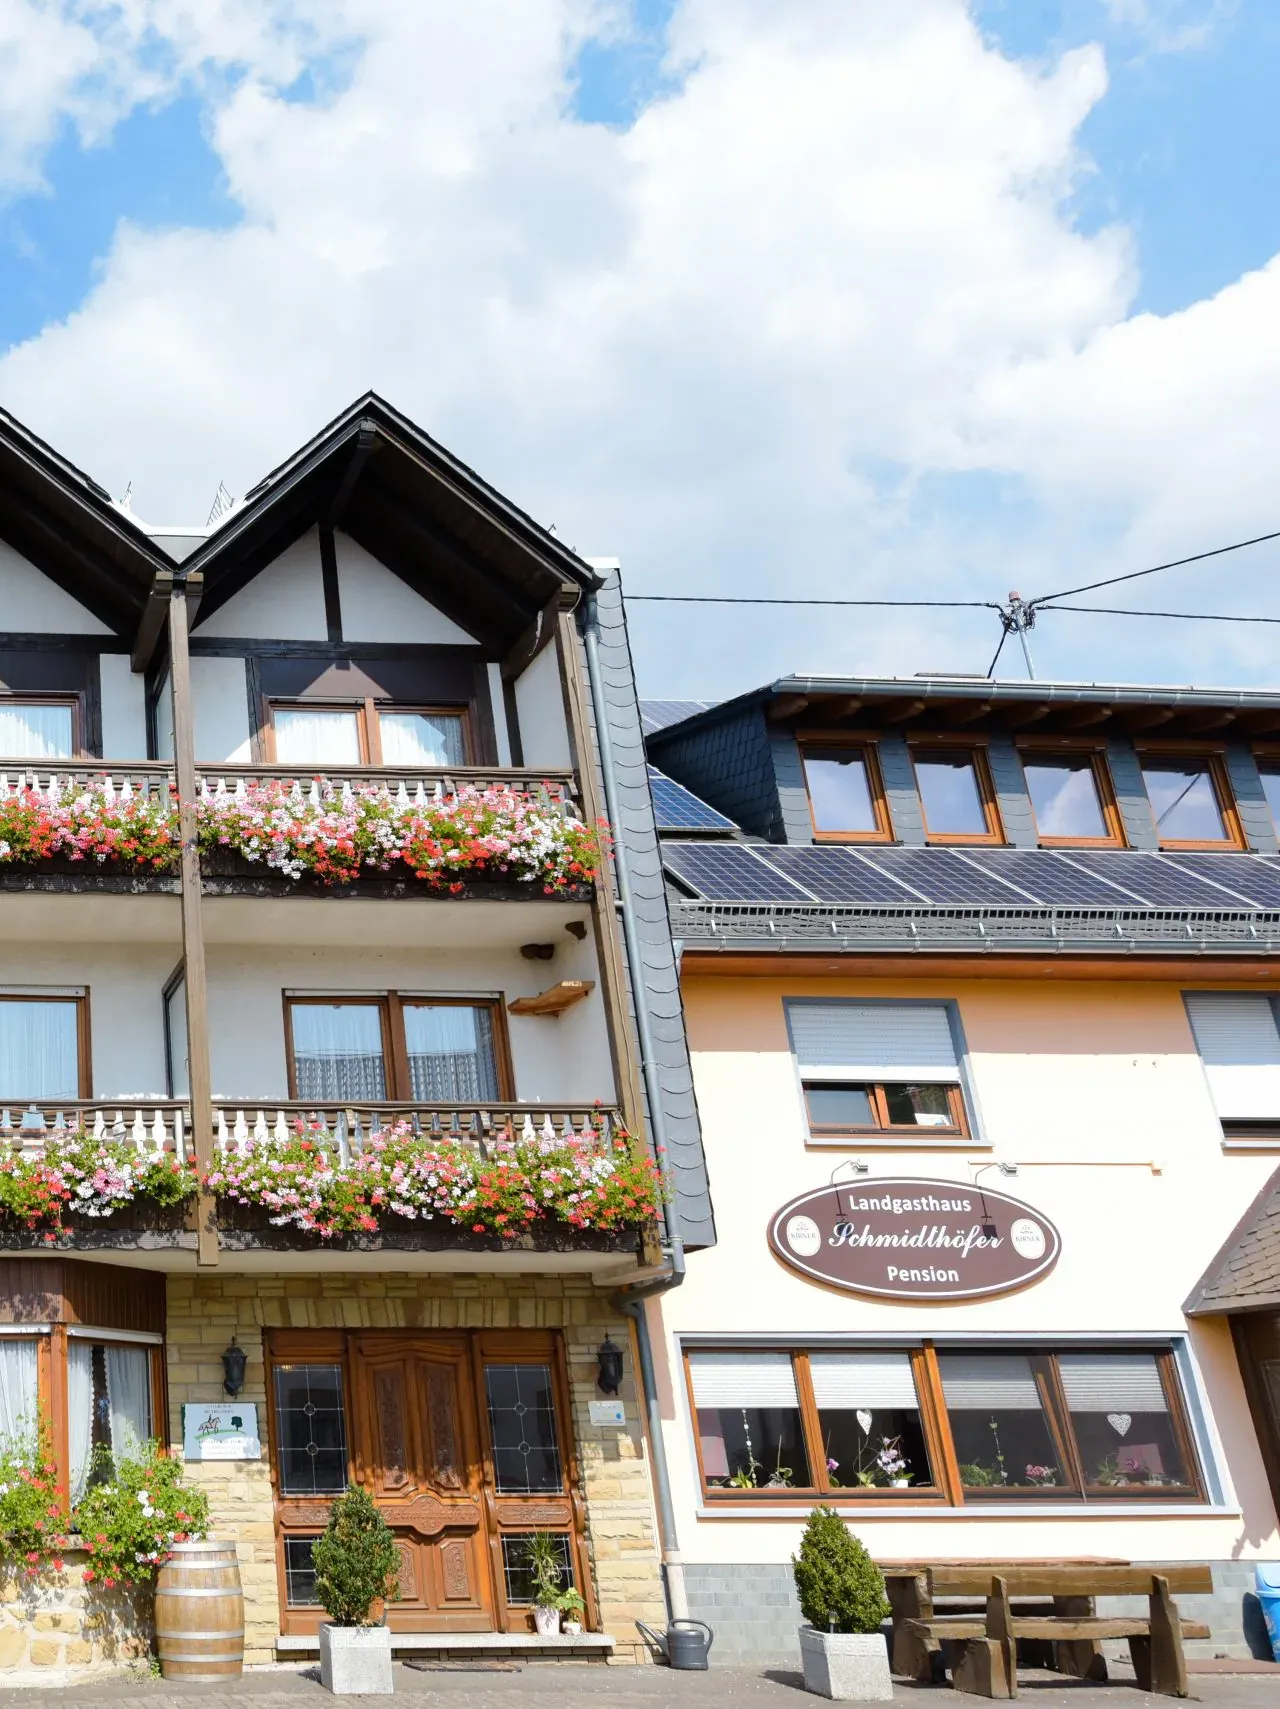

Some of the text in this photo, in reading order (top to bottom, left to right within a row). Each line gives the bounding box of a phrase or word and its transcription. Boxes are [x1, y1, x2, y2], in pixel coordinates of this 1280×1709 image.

[849, 1194, 972, 1214] Landgasthaus
[828, 1222, 1004, 1258] Schmidthöfer
[887, 1265, 960, 1282] Pension
